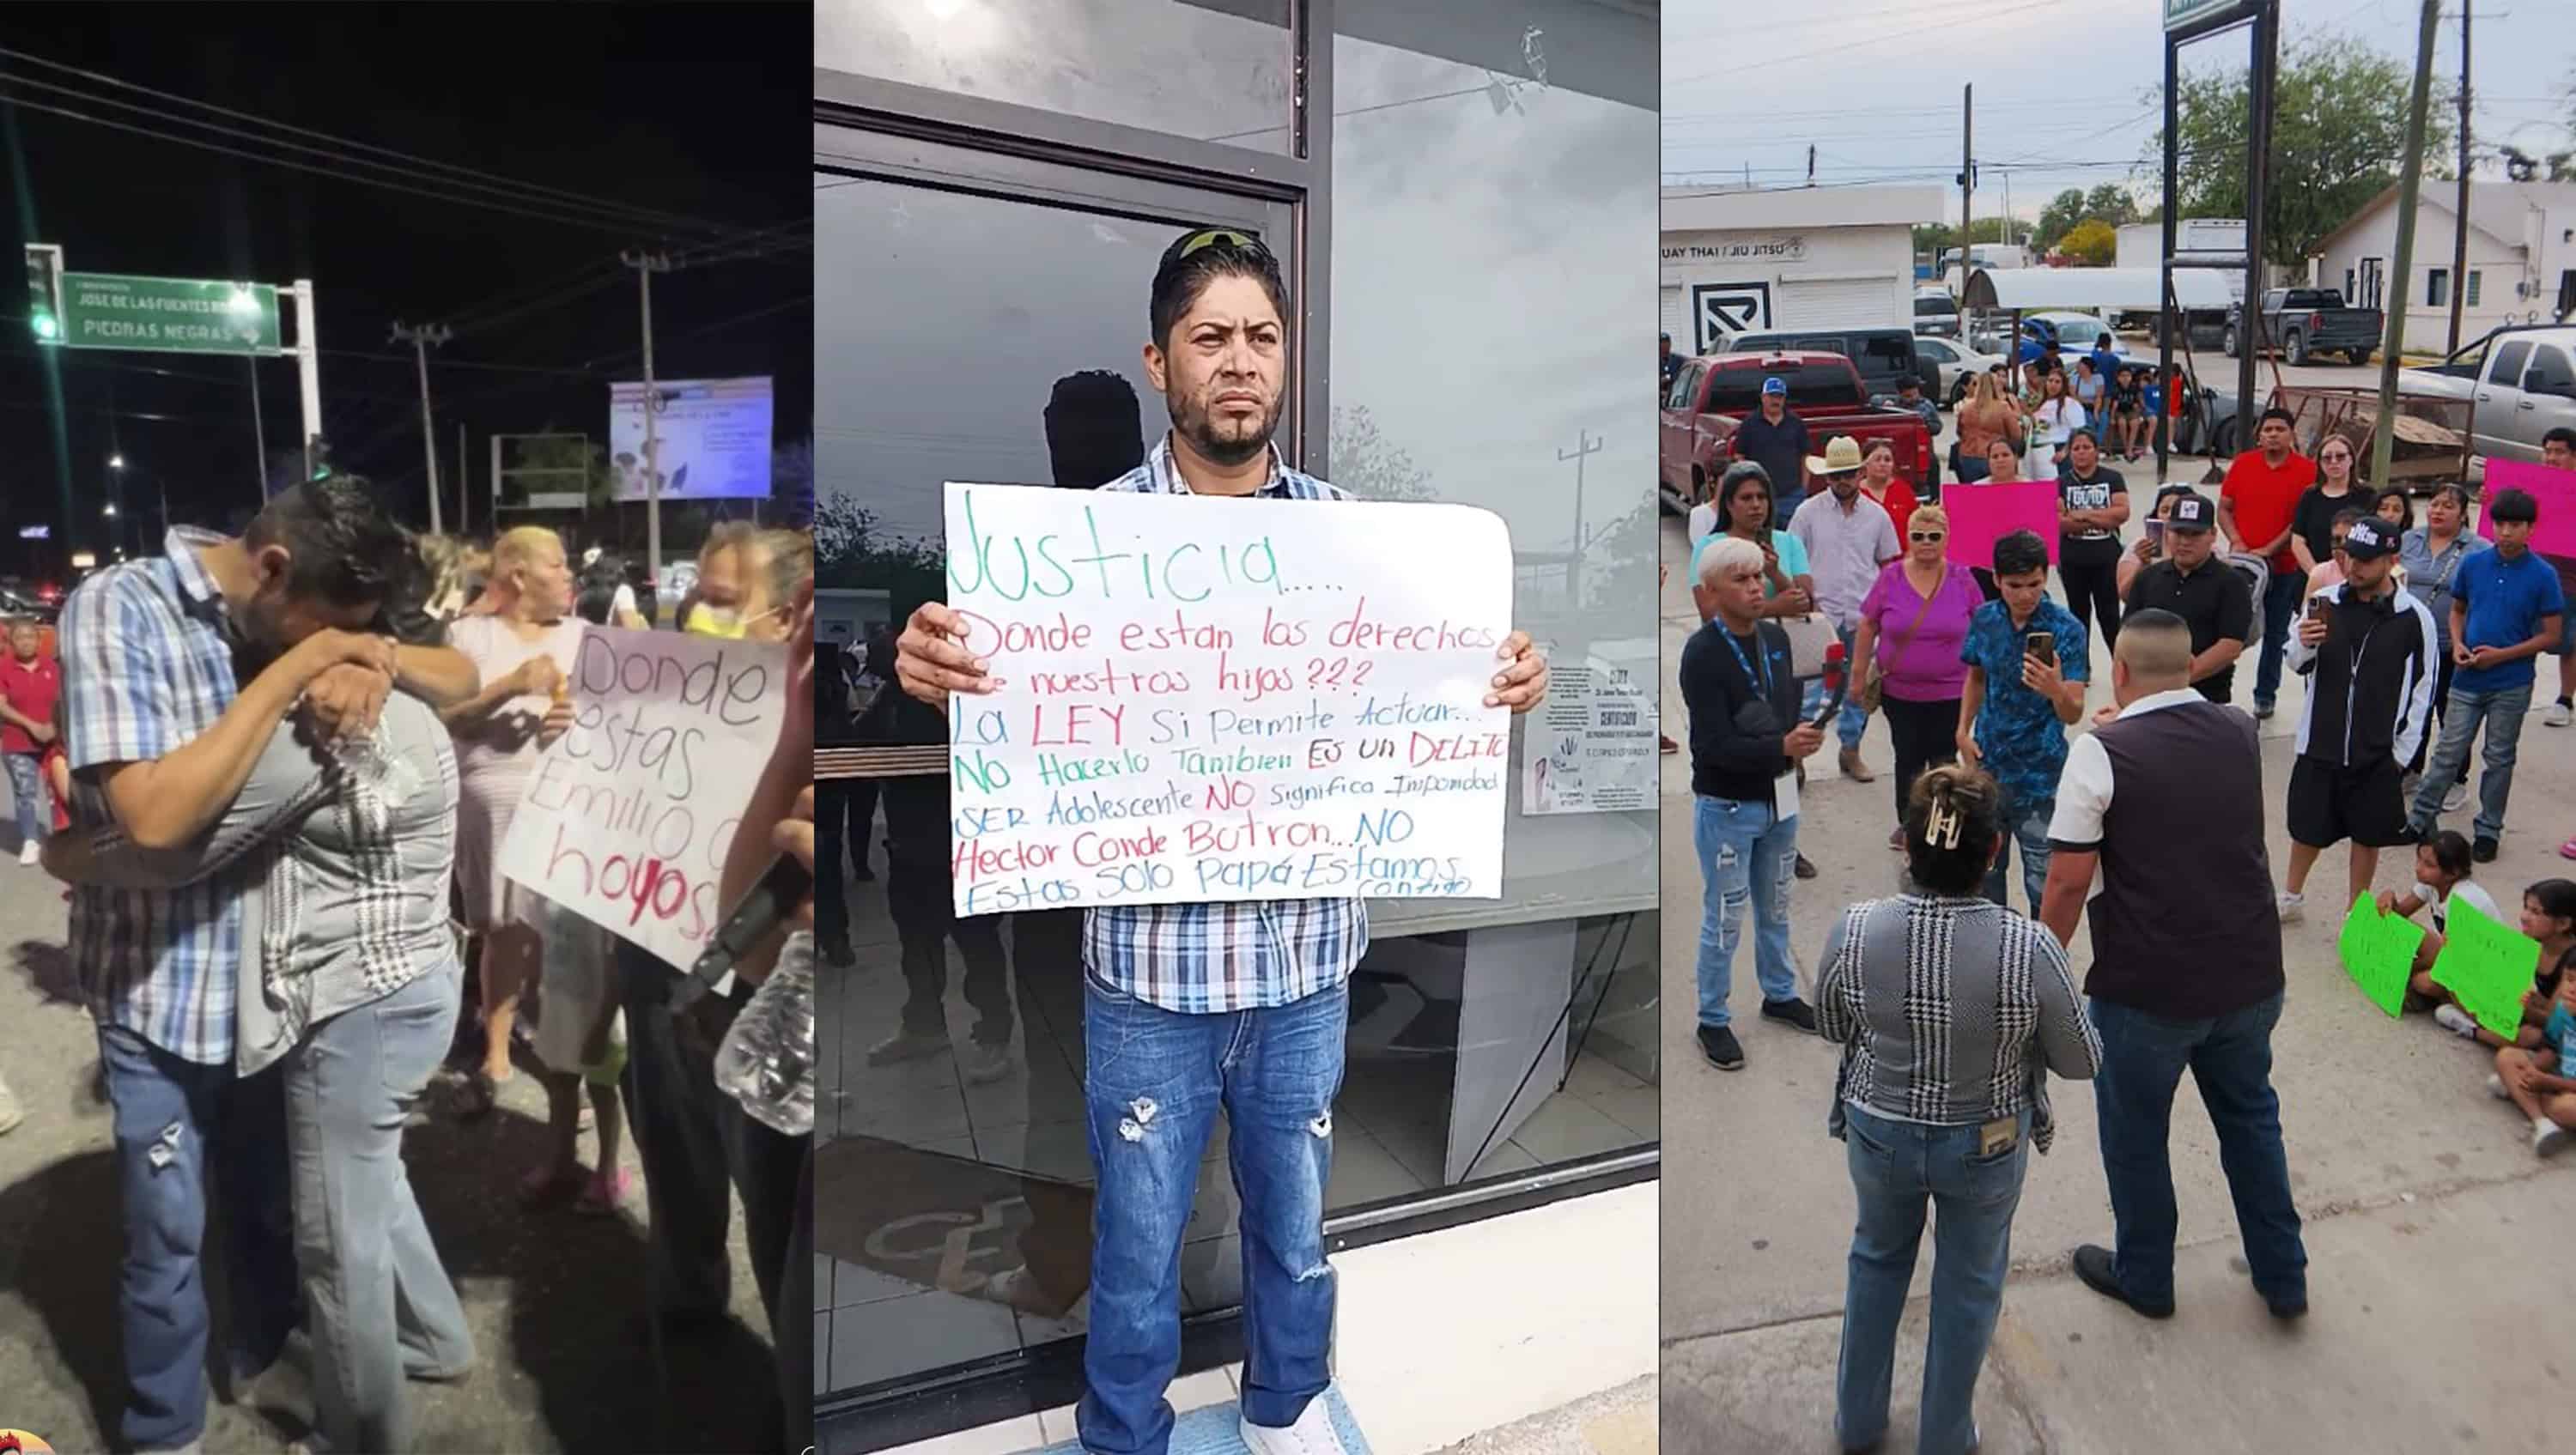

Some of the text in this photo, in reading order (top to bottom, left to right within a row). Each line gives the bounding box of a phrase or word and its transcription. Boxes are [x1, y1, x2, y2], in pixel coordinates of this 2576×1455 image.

[1690, 246, 1719, 258] THAI
[1730, 246, 1749, 257] JIU
[1753, 244, 1784, 256] JITSU
[84, 319, 233, 342] PIEDRAS NEGRAS
[951, 607, 1091, 659] Donde
[1120, 609, 1233, 651] estan
[580, 634, 767, 726] Donde
[1032, 704, 1124, 746] LEY
[1150, 709, 1189, 743] Si
[564, 703, 706, 801] estas
[1038, 749, 1150, 786] Hacerlo
[1047, 779, 1194, 826] Adolescente
[1206, 773, 1256, 811] NO
[951, 838, 1061, 883] Hector
[1072, 826, 1168, 868] Conde
[961, 876, 1082, 914] Estas
